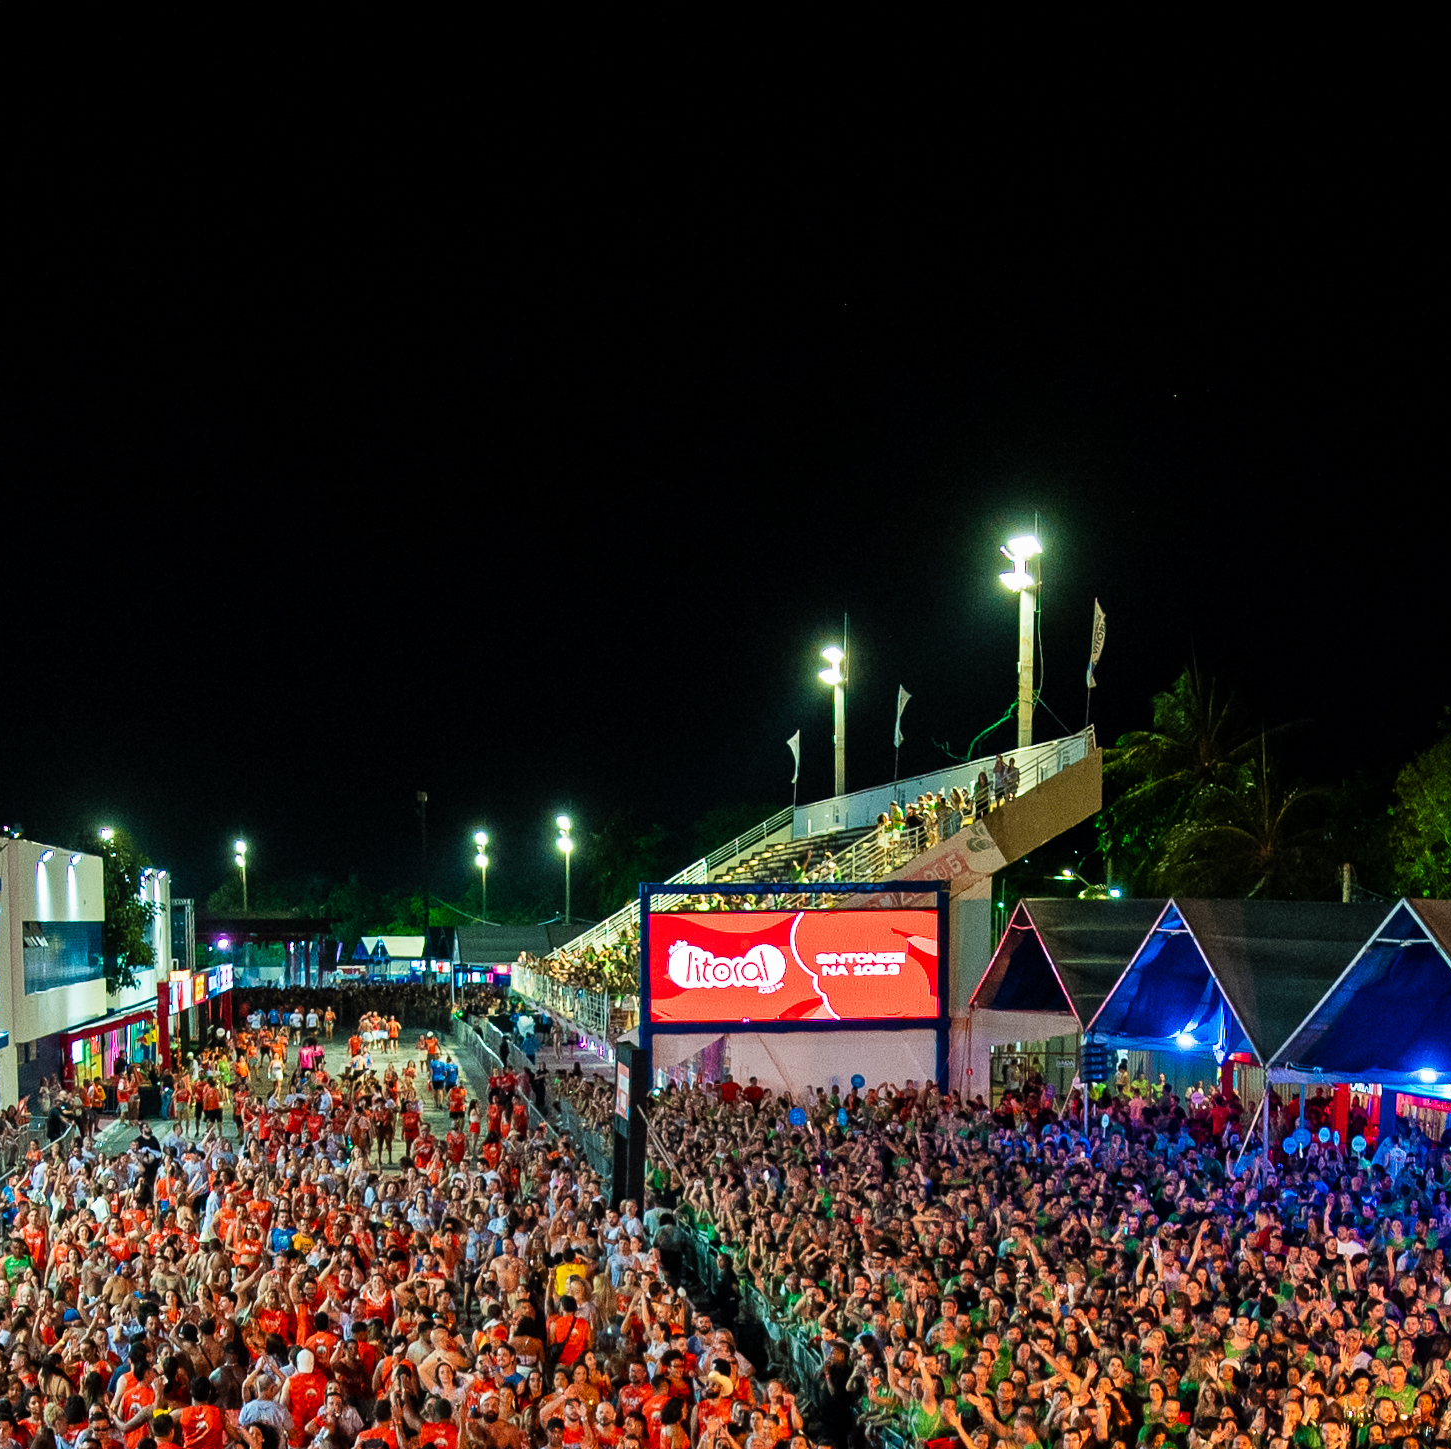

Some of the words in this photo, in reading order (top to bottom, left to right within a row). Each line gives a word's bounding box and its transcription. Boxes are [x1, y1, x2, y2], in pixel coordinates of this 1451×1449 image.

[815, 952, 906, 965] SINTONIZE
[686, 951, 770, 983] litoral
[822, 965, 848, 976] NA
